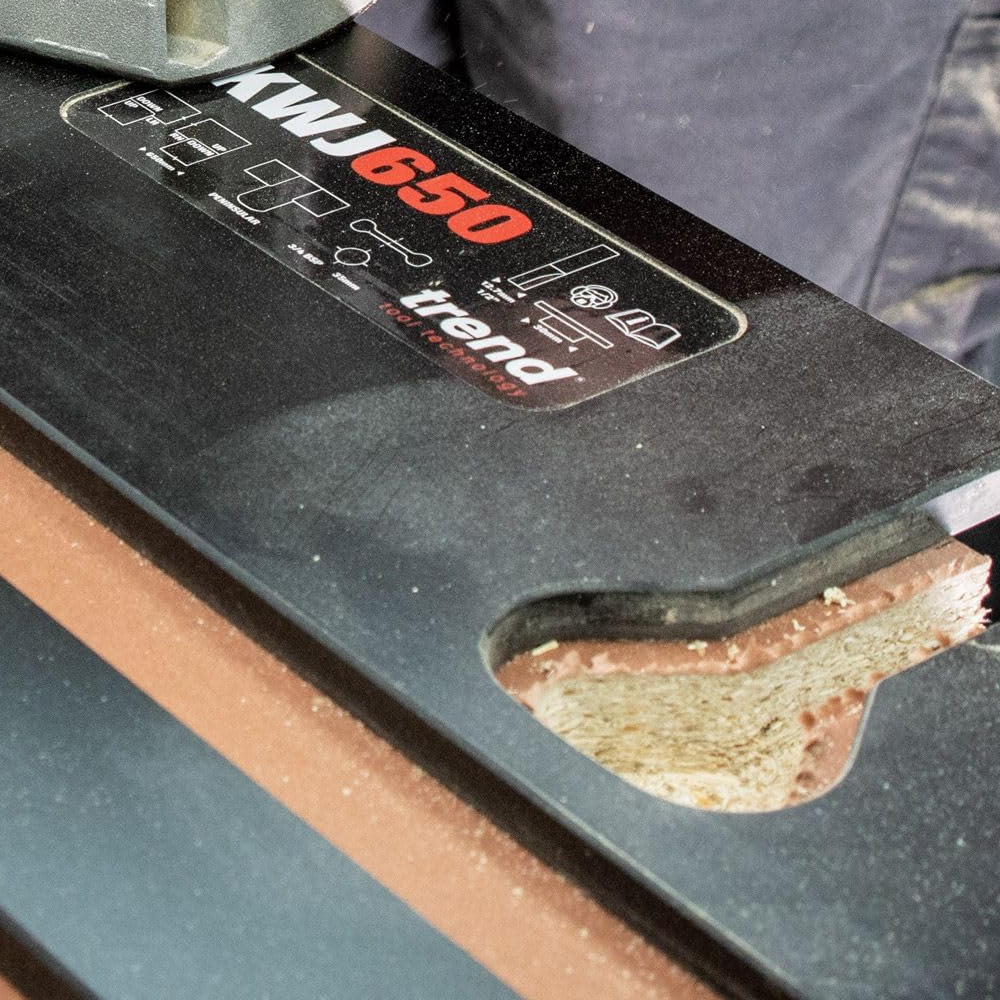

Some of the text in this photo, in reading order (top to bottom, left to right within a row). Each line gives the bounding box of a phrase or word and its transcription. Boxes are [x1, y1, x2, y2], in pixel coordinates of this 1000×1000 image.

[136, 96, 164, 112] DOWN
[187, 140, 215, 157] DOWN
[211, 64, 534, 244] KWJ650
[380, 302, 527, 397] tool technology
